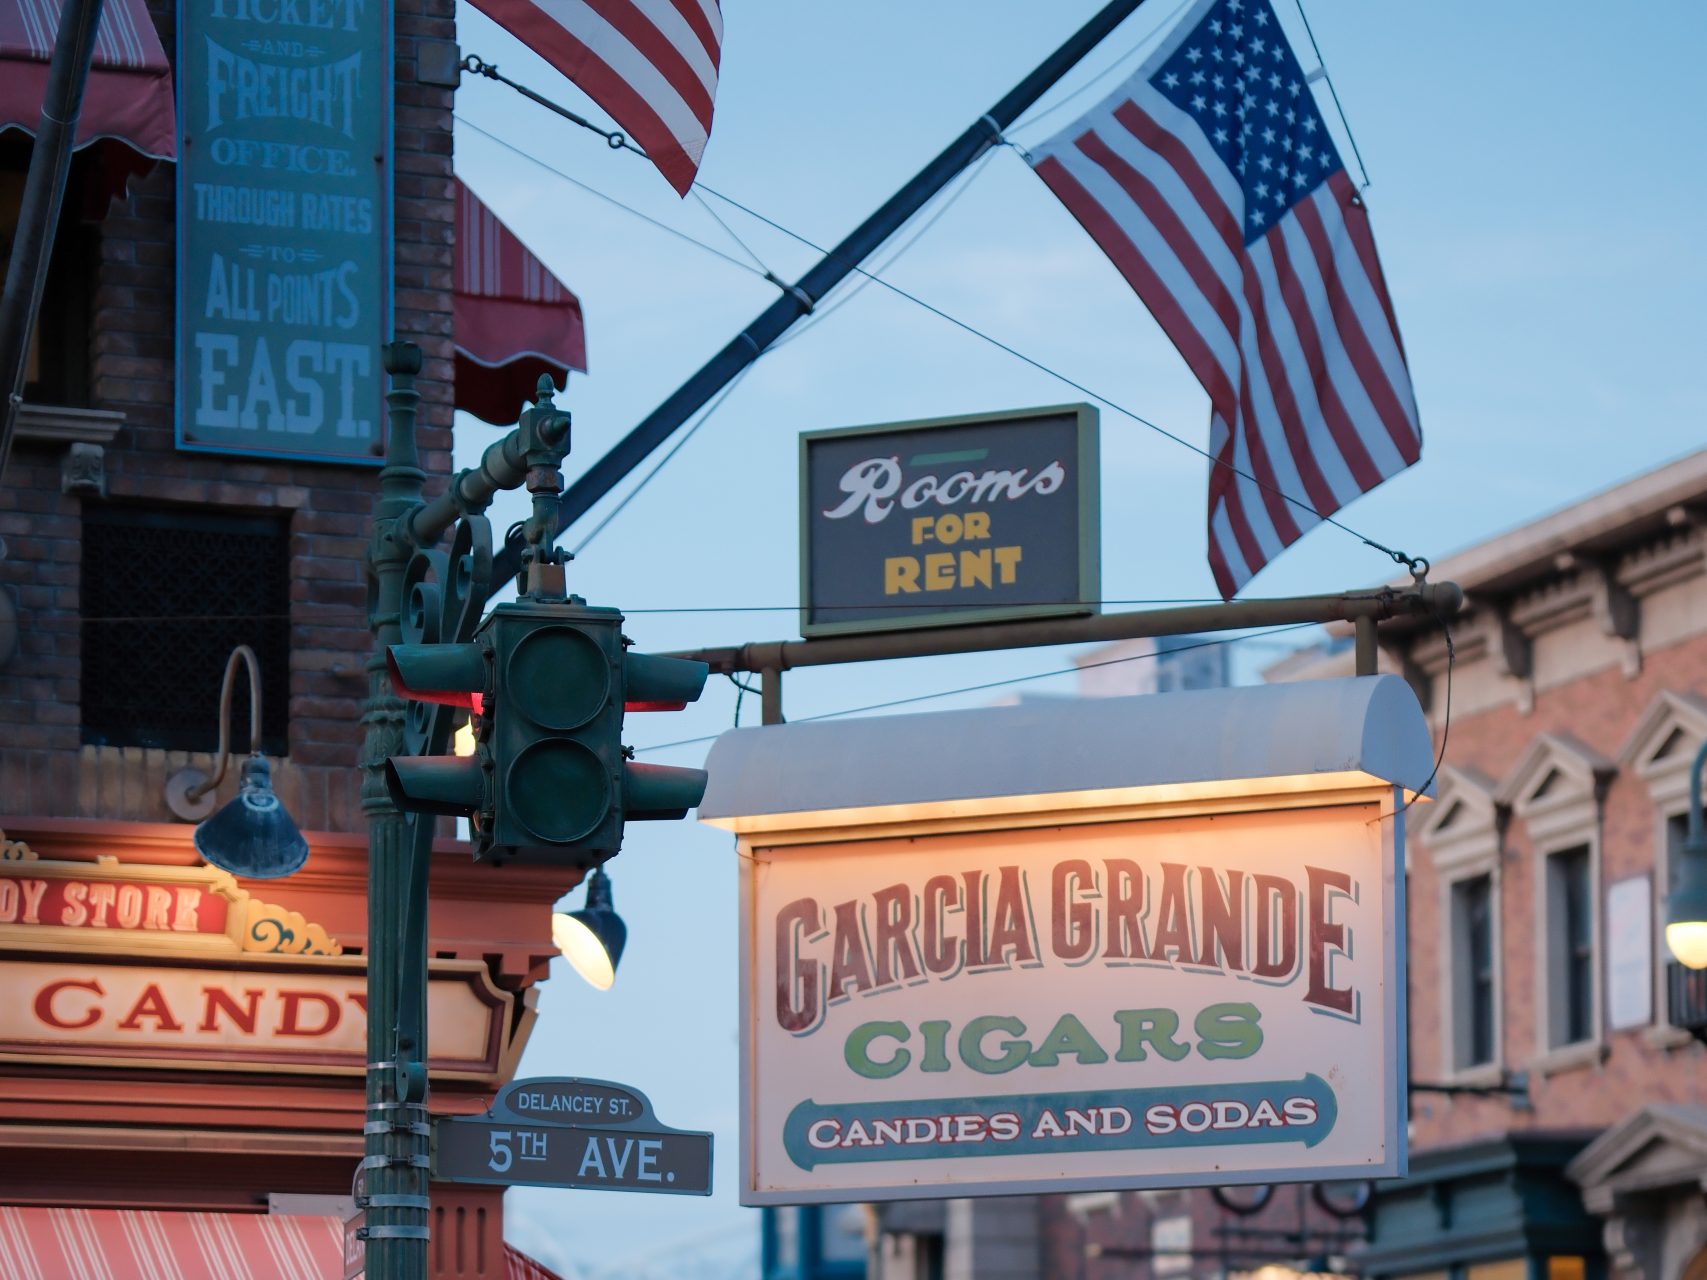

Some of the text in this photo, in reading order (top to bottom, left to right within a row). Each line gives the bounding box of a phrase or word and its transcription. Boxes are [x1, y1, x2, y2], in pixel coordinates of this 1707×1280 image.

[262, 41, 304, 58] AND
[203, 33, 363, 140] FREIGHT
[210, 137, 357, 177] OFFICE.
[194, 183, 372, 234] THROUGH RATES
[269, 246, 296, 263] TO
[205, 252, 359, 331] ALL POINTS
[195, 332, 371, 439] EAST.
[822, 455, 1066, 524] Rooms
[911, 511, 992, 545] FOR
[884, 546, 1022, 595] RENT
[775, 857, 1361, 1037] GARCIA GRANDE
[843, 1002, 1265, 1080] CIGARS
[518, 1093, 633, 1116] DELANCEY ST.
[806, 1096, 1319, 1150] CANDIES AND SODAS
[488, 1130, 676, 1184] 5TH AVE.
